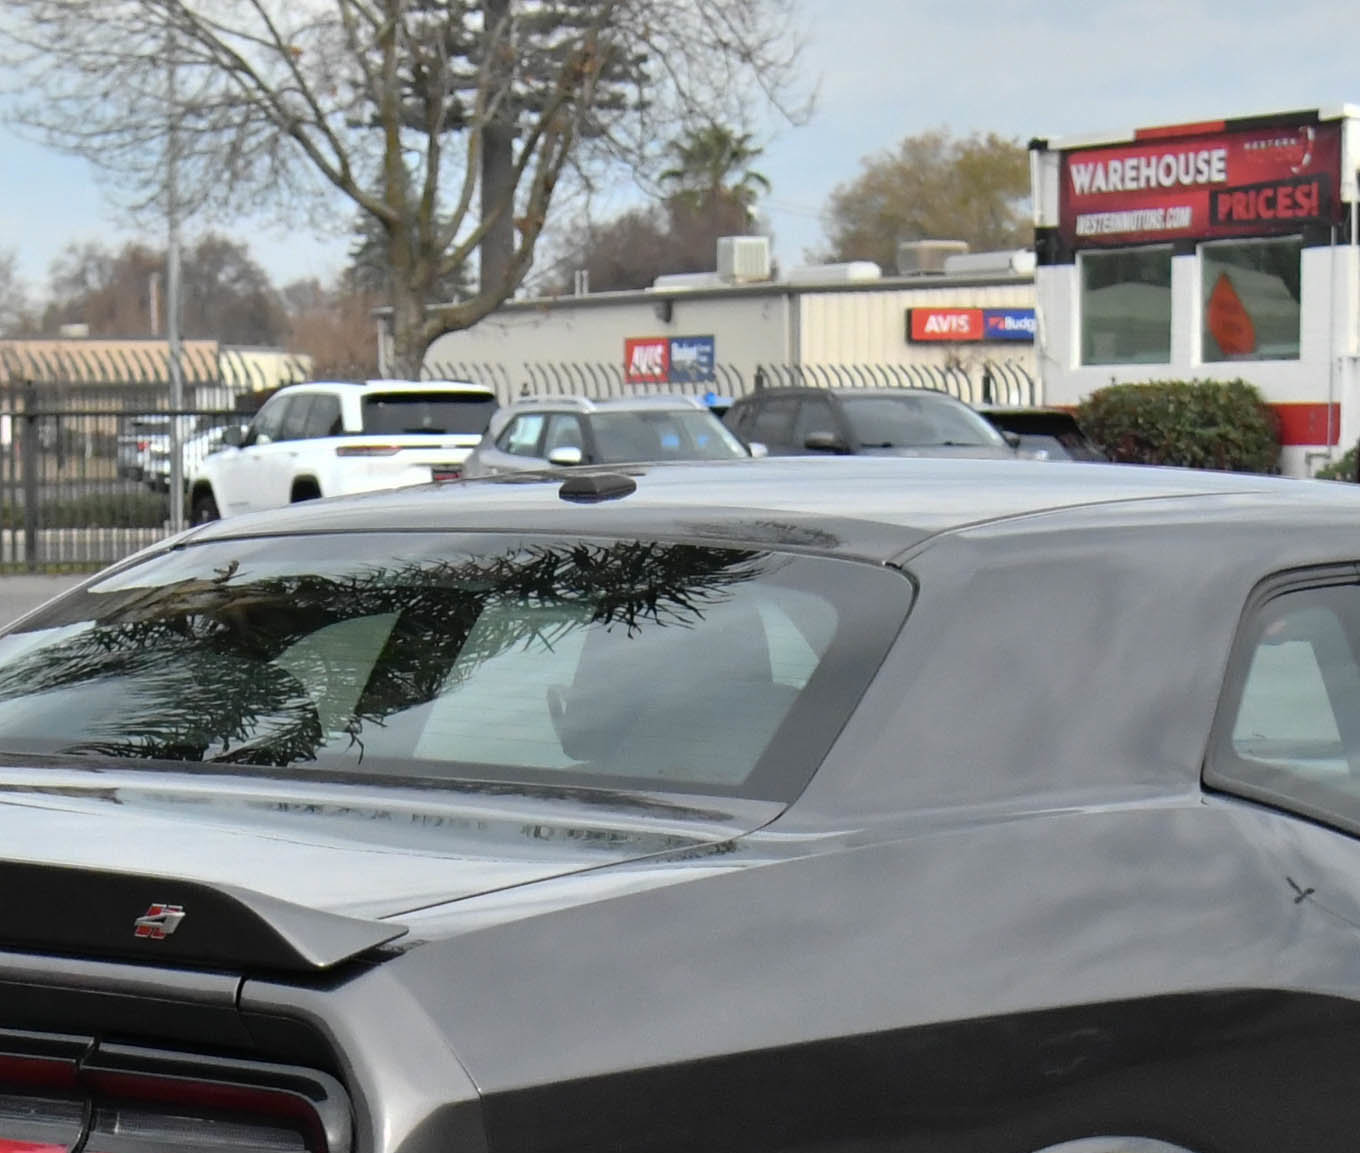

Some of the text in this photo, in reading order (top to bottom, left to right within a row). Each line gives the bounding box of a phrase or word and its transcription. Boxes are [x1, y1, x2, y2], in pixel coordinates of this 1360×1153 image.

[1070, 148, 1228, 196] WAREHOUSE
[1217, 181, 1320, 221] PRICES!
[924, 314, 970, 333] AVIS
[630, 344, 664, 374] AVIS
